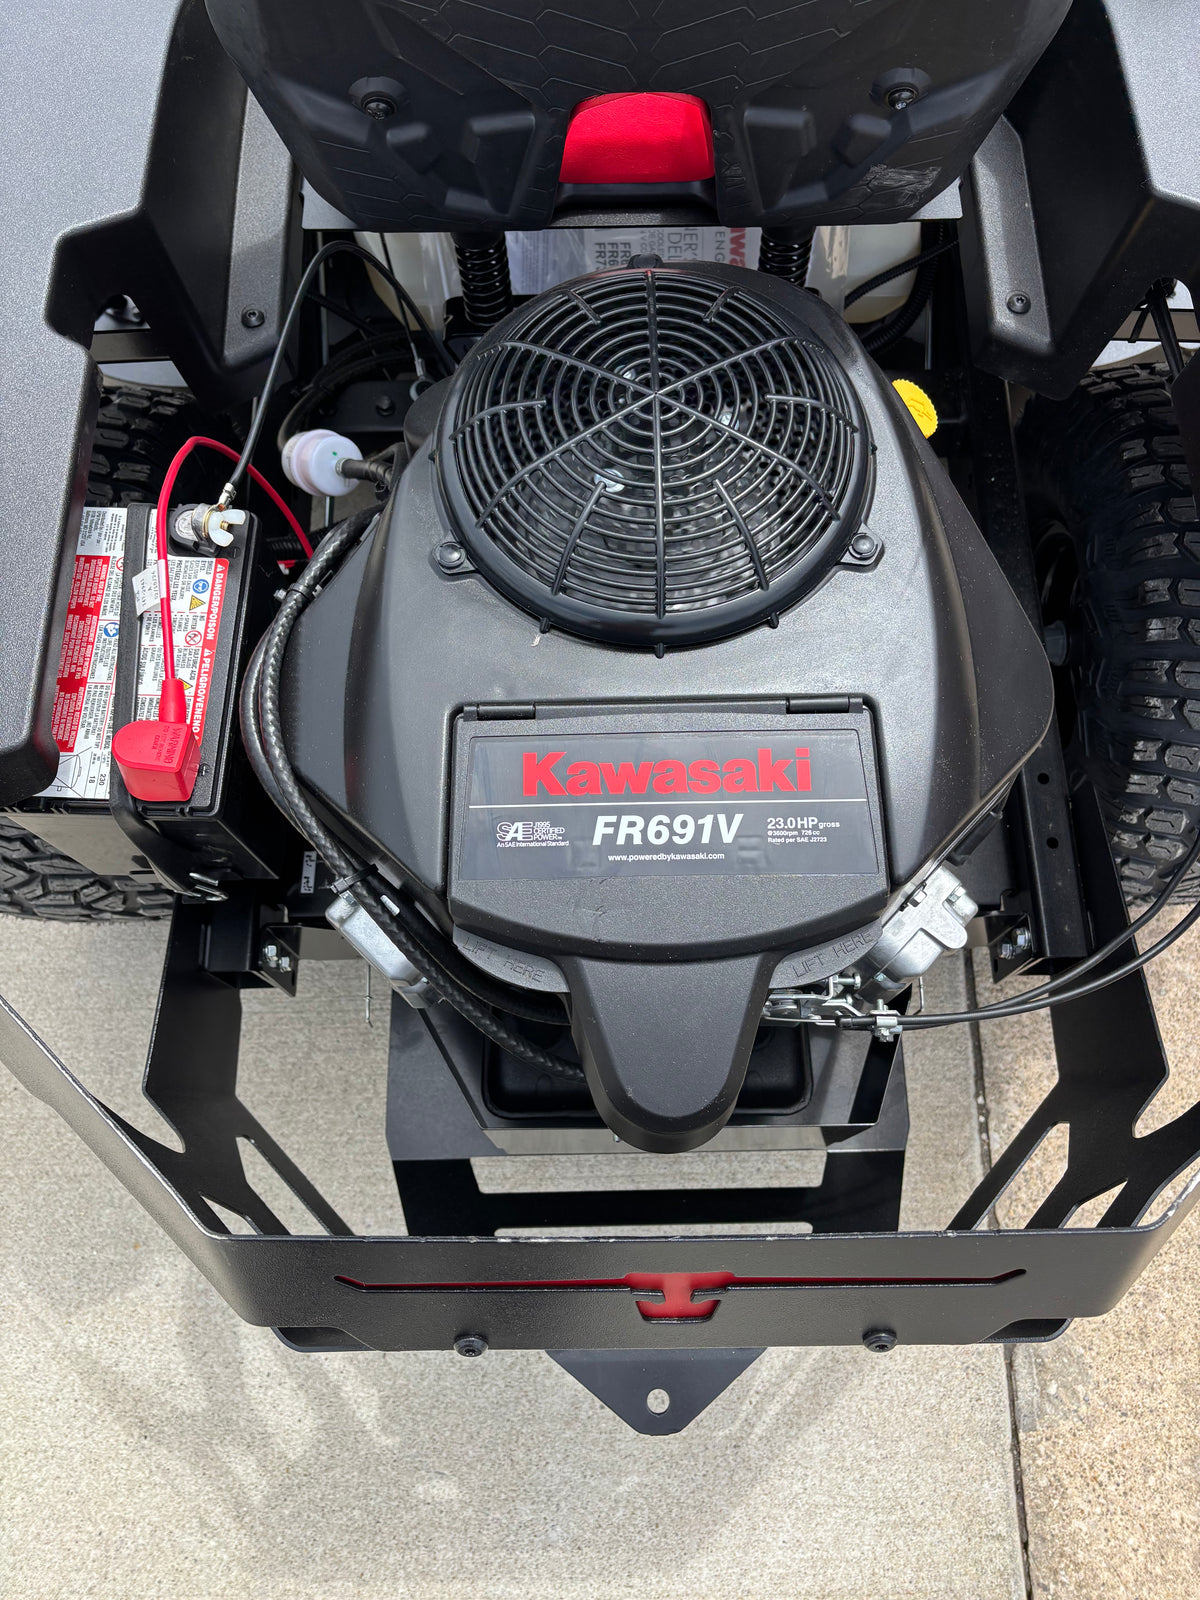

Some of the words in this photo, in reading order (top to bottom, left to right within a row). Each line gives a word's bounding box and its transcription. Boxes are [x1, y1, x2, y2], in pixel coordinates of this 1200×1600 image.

[205, 573, 223, 639] DANGER/POISON
[98, 773, 106, 785] 230
[522, 748, 812, 796] Kawasaki
[496, 822, 534, 841] SAE
[592, 814, 744, 846] FR691V
[608, 852, 725, 862] www.poweredbykawasaki.com
[462, 937, 498, 960] LIFT
[792, 952, 824, 978] LIFT
[832, 930, 874, 958] HERE
